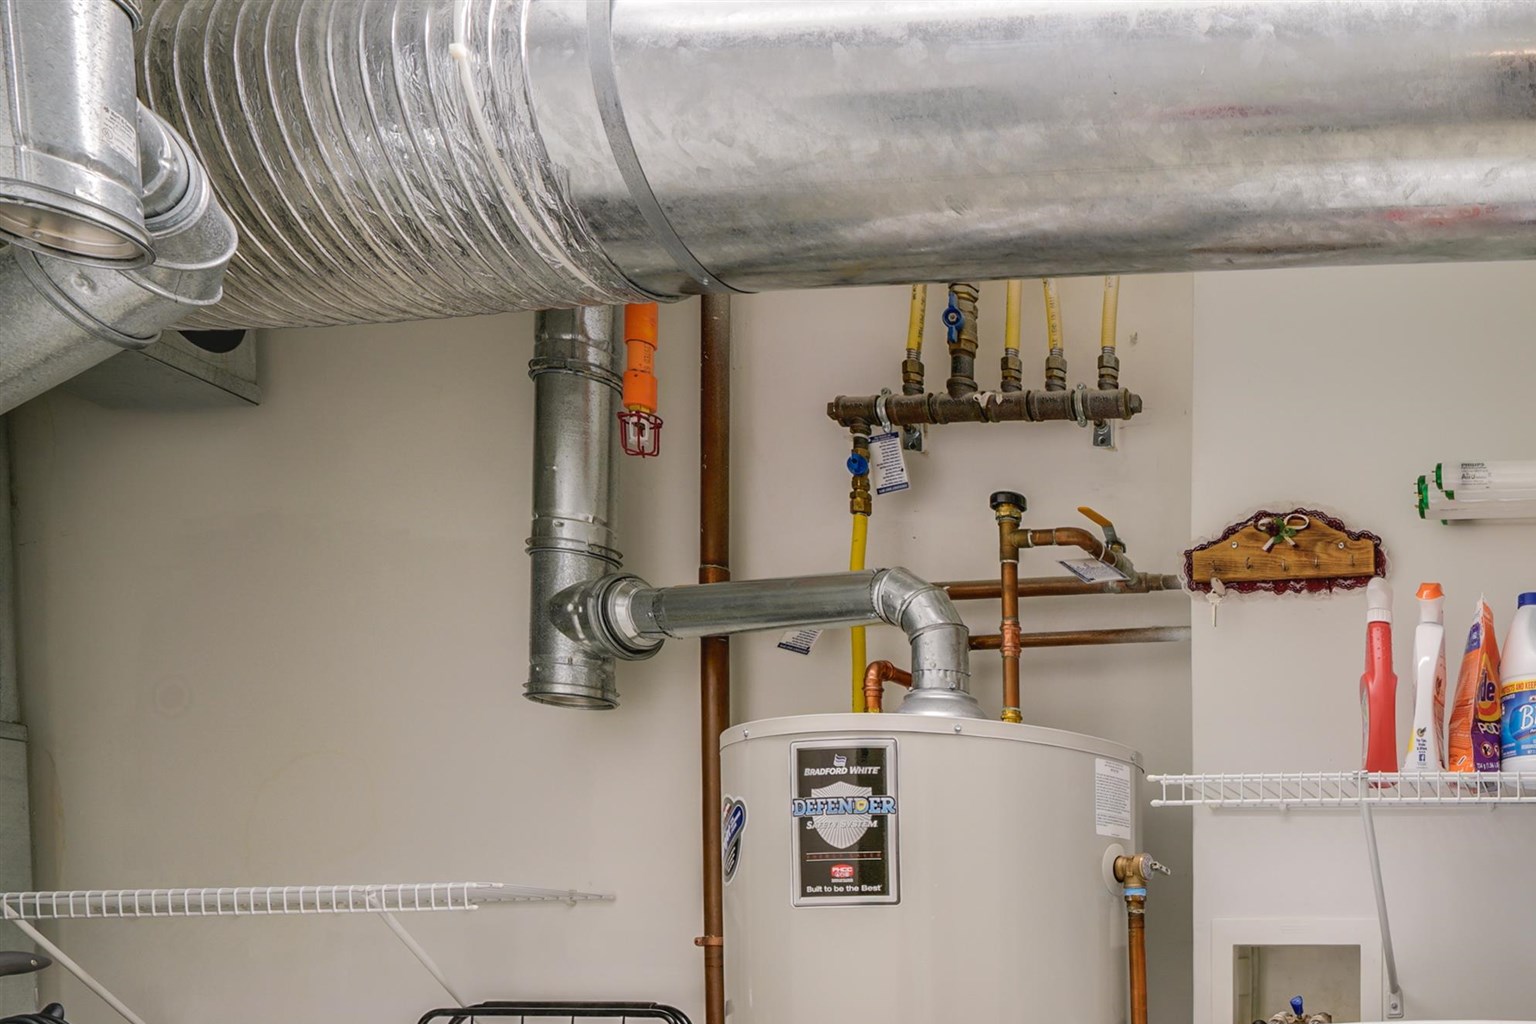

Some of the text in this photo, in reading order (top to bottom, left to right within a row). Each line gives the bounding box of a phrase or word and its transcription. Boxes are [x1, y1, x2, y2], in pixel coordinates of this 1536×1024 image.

[1478, 722, 1501, 734] POD
[804, 766, 880, 776] BRADFORD WHITE
[793, 796, 896, 816] DEFENDER
[806, 885, 822, 893] Built
[825, 885, 832, 893] to
[834, 885, 844, 893] be
[861, 884, 881, 892] Best
